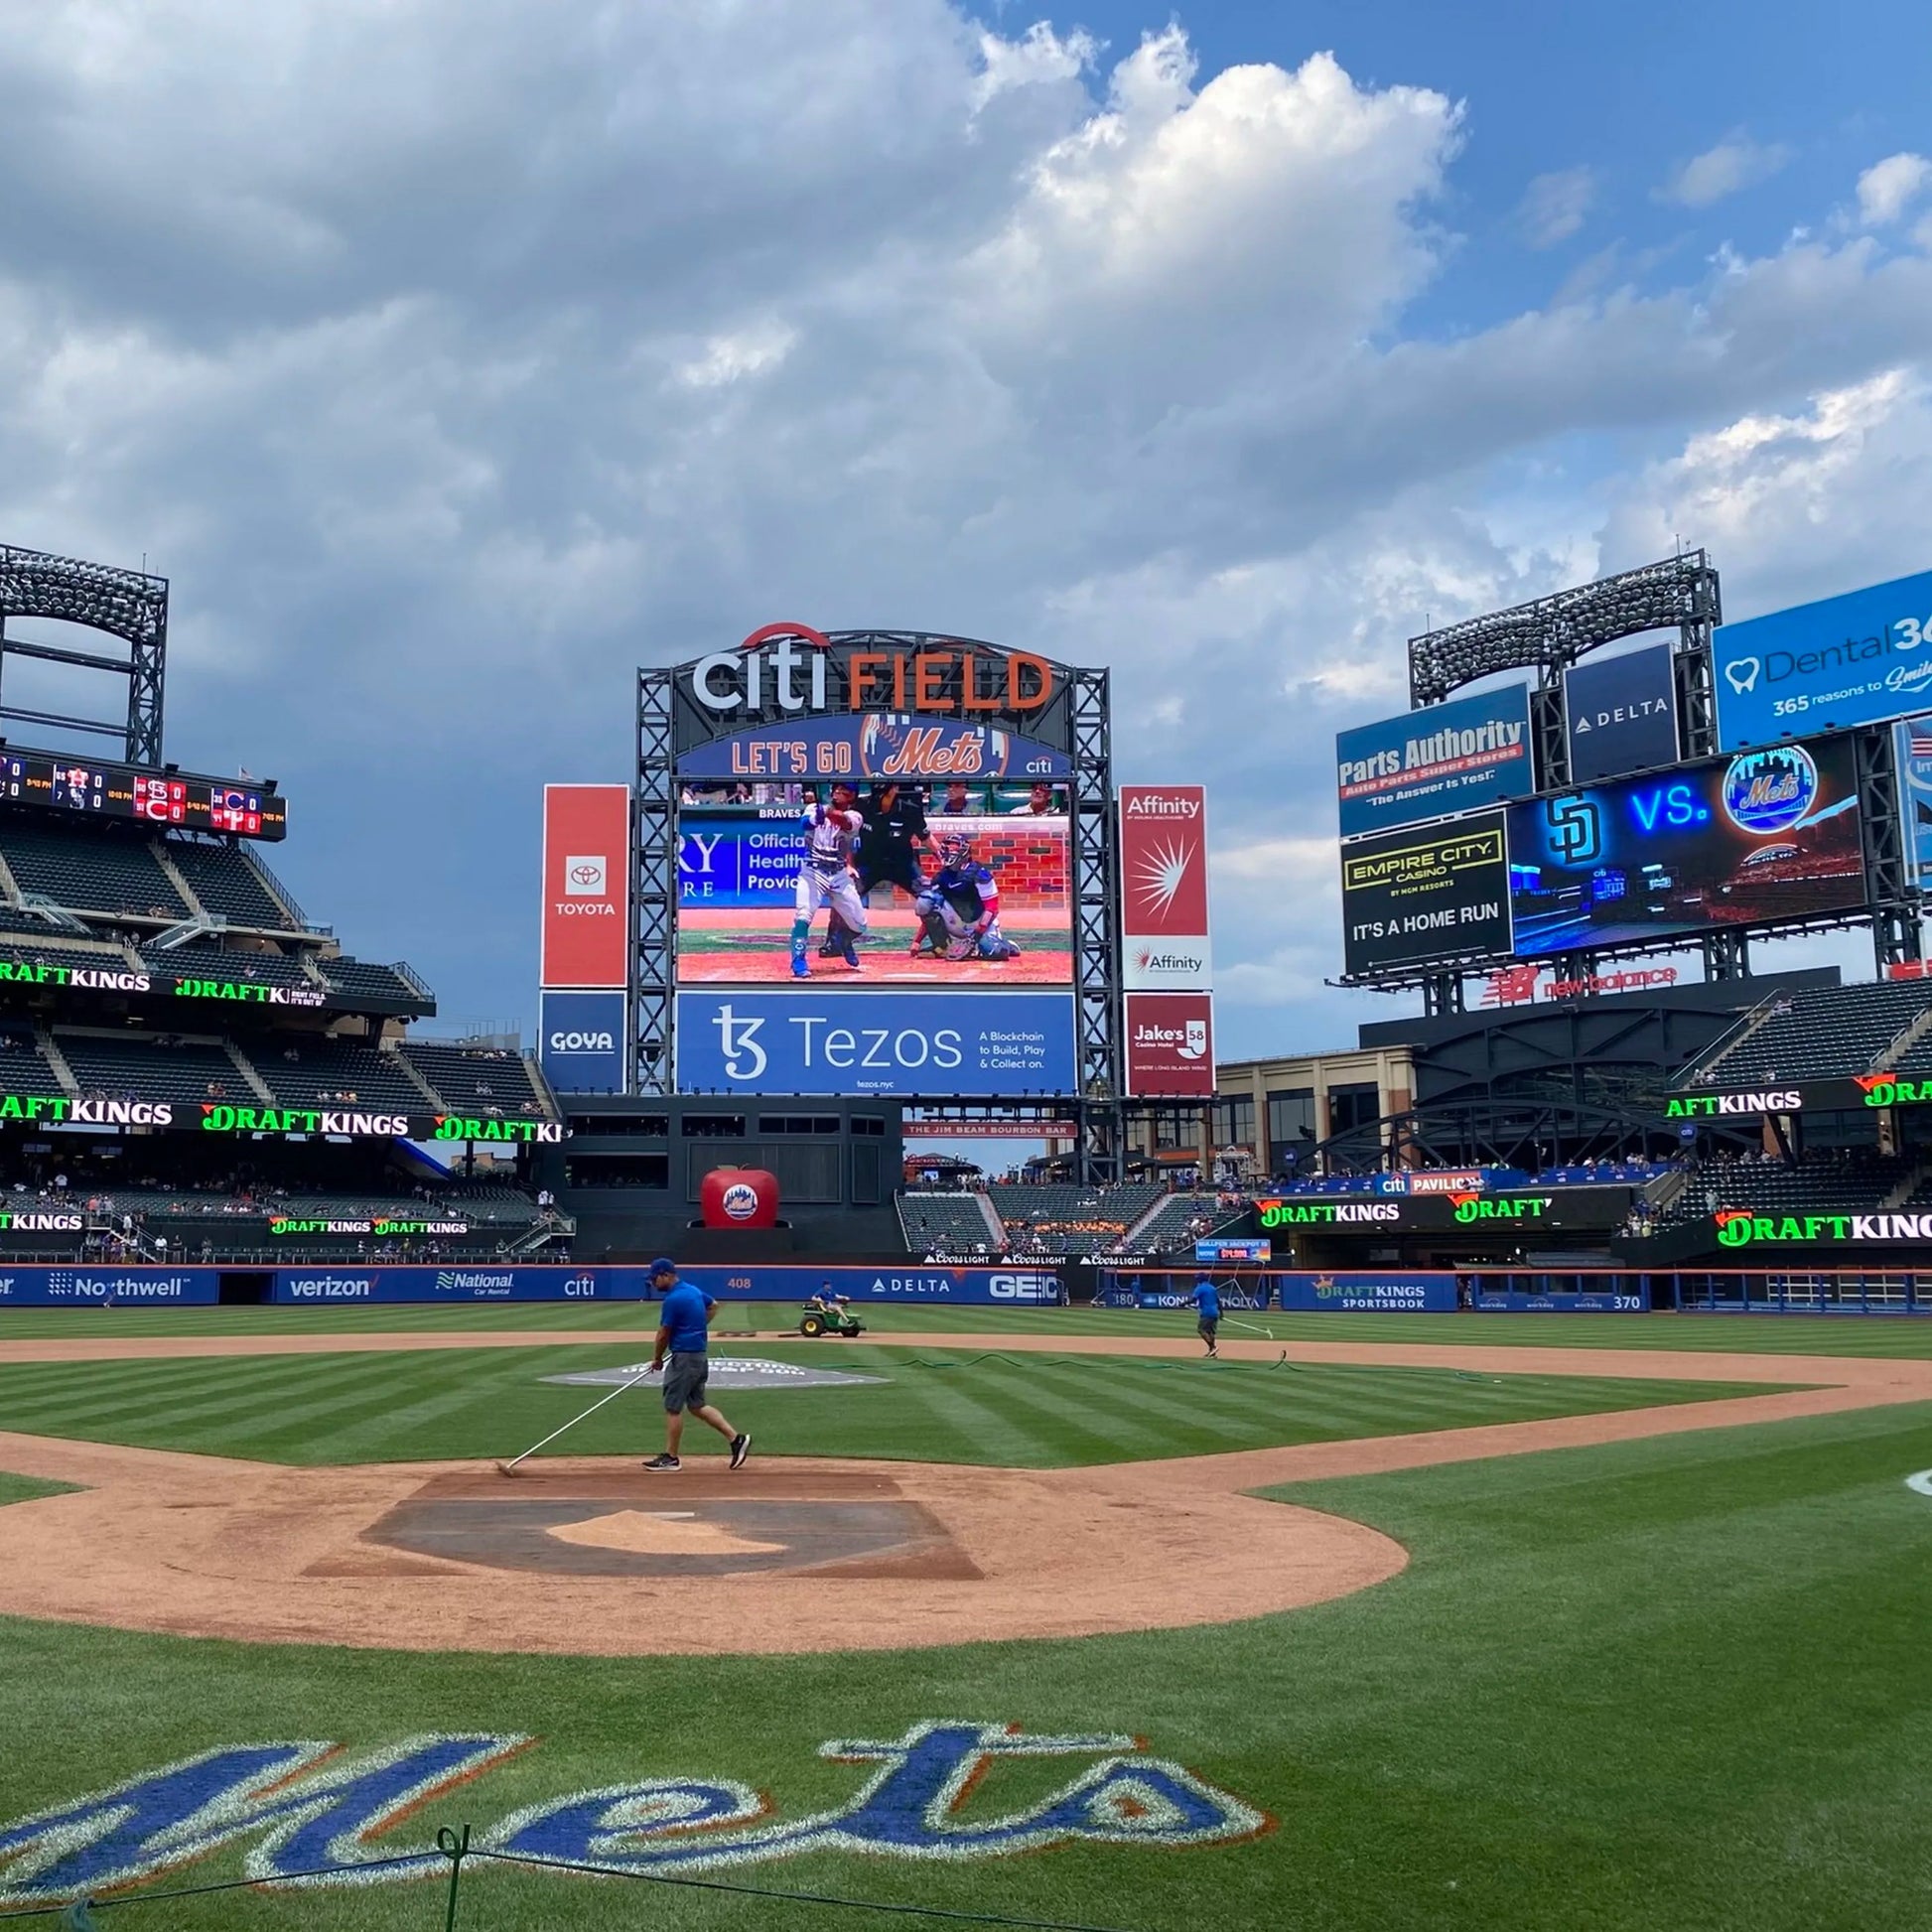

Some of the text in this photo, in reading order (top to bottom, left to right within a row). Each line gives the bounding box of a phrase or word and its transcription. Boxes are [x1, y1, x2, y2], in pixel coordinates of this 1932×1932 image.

[693, 637, 1053, 711] citi FIELD
[1772, 695, 1810, 717] 365
[1812, 685, 1865, 706] reasons
[1867, 680, 1882, 692] to
[1596, 697, 1668, 727] DELTA
[732, 727, 984, 775] LET'S GO Mets
[1339, 720, 1522, 788] Parts Authority
[12, 762, 20, 776] 0
[1026, 759, 1052, 774] citi
[1345, 749, 1519, 797] Auto Parts Super Stores
[11, 782, 19, 796] 0
[94, 774, 102, 788] 0
[173, 786, 181, 800] 0
[1396, 781, 1445, 801] Answer
[93, 794, 101, 808] 0
[249, 798, 256, 811] 0
[1127, 795, 1200, 819] Affinity
[1631, 784, 1710, 831] VS.
[1739, 772, 1801, 810] Mets
[172, 805, 180, 819] 0
[759, 808, 802, 819] BRAVES
[248, 817, 256, 830] 0
[1353, 841, 1492, 880] EMPIRE CITY
[1396, 866, 1448, 883] CASINO
[1419, 879, 1454, 893] RESORTS
[555, 902, 616, 915] TOYOTA
[1352, 901, 1500, 942] IT'S A HOME RUN
[1149, 955, 1202, 973] Affinity
[1543, 966, 1678, 998] new balance
[979, 1031, 1044, 1041] A Blockchain
[1133, 1024, 1204, 1041] Jake's 58
[550, 1032, 613, 1051] GOYA
[788, 1017, 963, 1068] Tezos
[979, 1044, 1045, 1058] to Build, Play
[979, 1058, 1044, 1069] & Collect on.
[1664, 1090, 1803, 1118] AFTKINGS
[202, 1104, 409, 1136] DRAFTKINGS
[908, 1125, 1068, 1135] THE JIM BEAM BOURBON BAR
[1382, 1173, 1483, 1192] citi PAVILIO
[1261, 1202, 1400, 1228] DRAFTKINGS
[1454, 1197, 1552, 1224] DRAFT
[271, 1219, 371, 1235] DRAFTKINGS
[374, 1219, 468, 1235] DRAFTKINGS
[963, 1255, 991, 1264] LIGHT
[1042, 1256, 1066, 1265] LIGHT
[1120, 1256, 1146, 1266] LIGHT
[290, 1276, 369, 1297] verizon
[453, 1273, 514, 1289] National
[564, 1276, 595, 1297] citi
[727, 1278, 752, 1289] 408
[891, 1279, 950, 1293] DELTA
[1316, 1285, 1426, 1300] DRAFTKINGS
[1341, 1299, 1426, 1309] SPORTSBOOK
[1613, 1296, 1641, 1310] 370
[0, 1719, 1279, 1905] Mets
